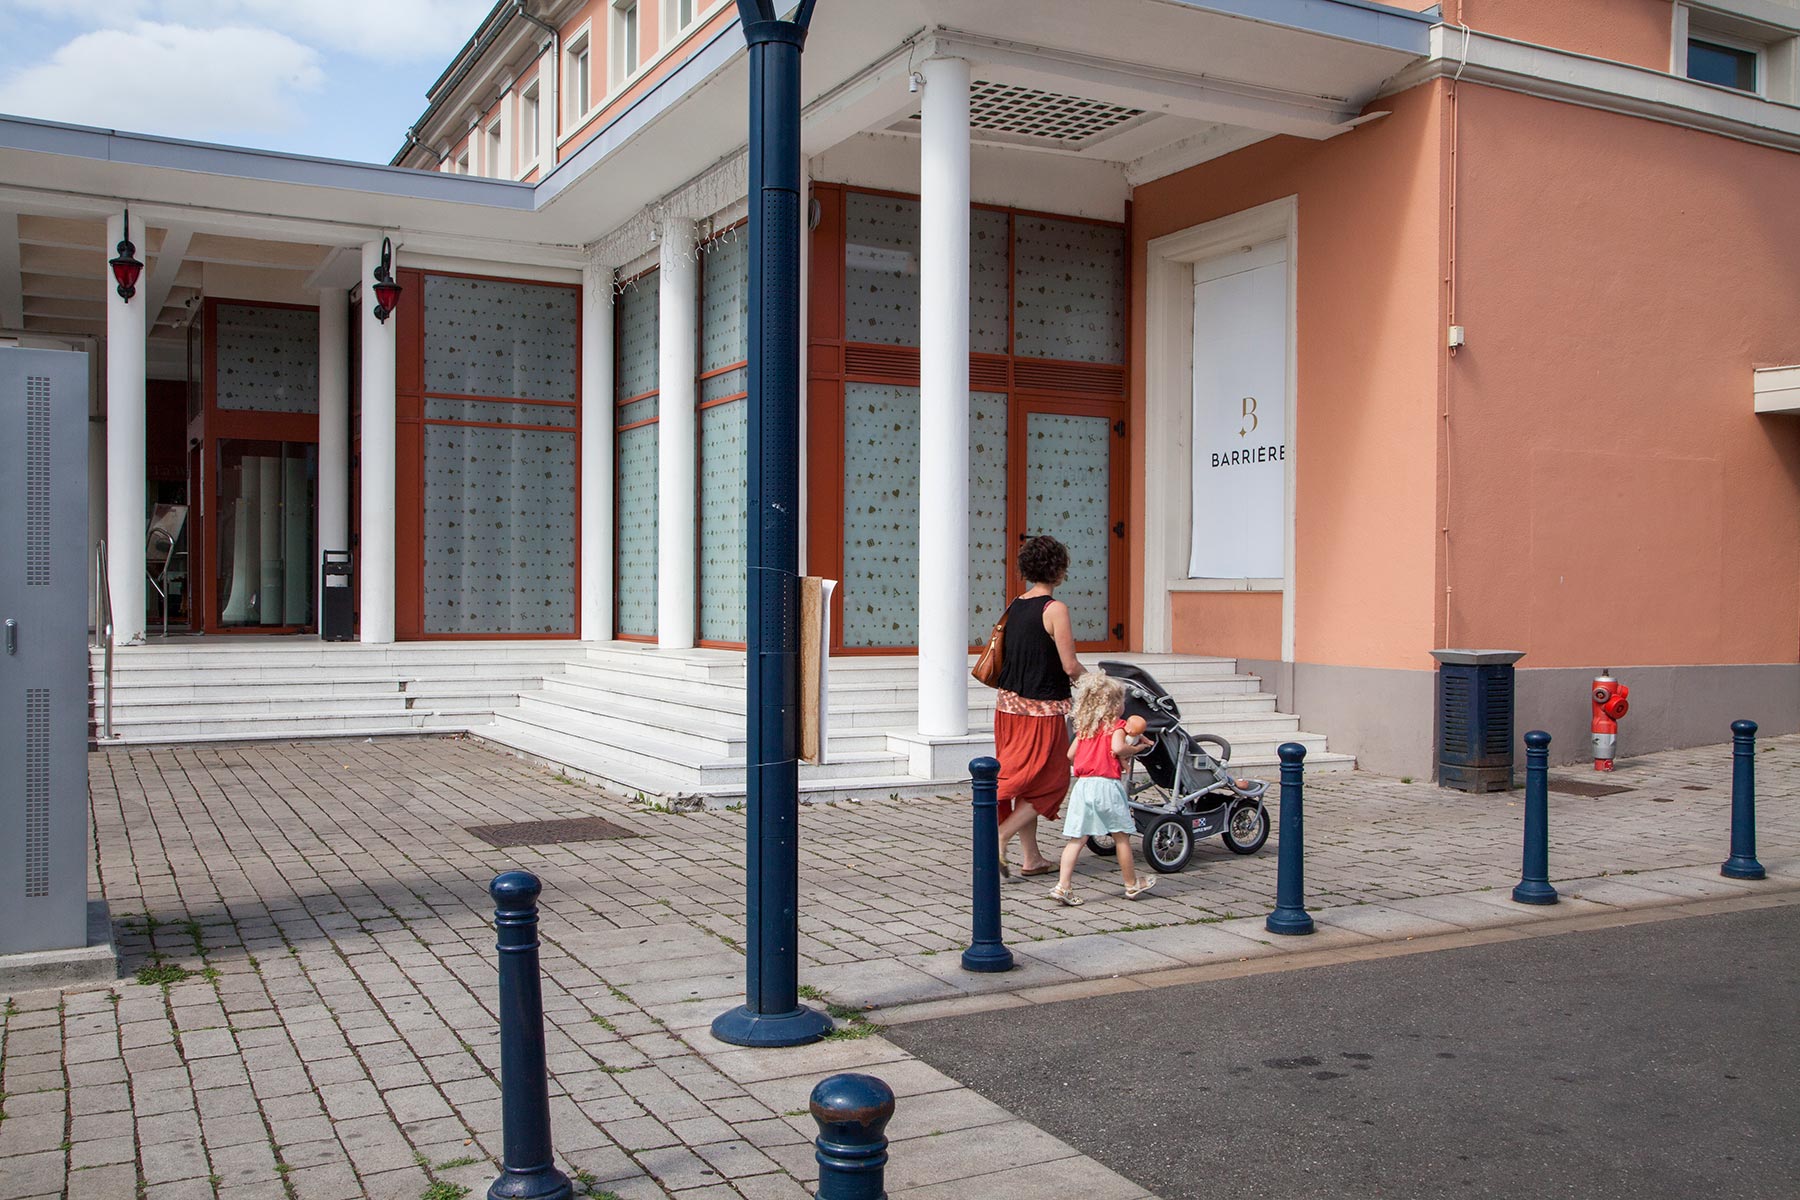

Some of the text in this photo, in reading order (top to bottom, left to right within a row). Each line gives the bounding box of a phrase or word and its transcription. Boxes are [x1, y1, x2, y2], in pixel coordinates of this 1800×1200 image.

[894, 388, 902, 399] A
[1088, 433, 1096, 443] K
[1086, 527, 1095, 536] Q
